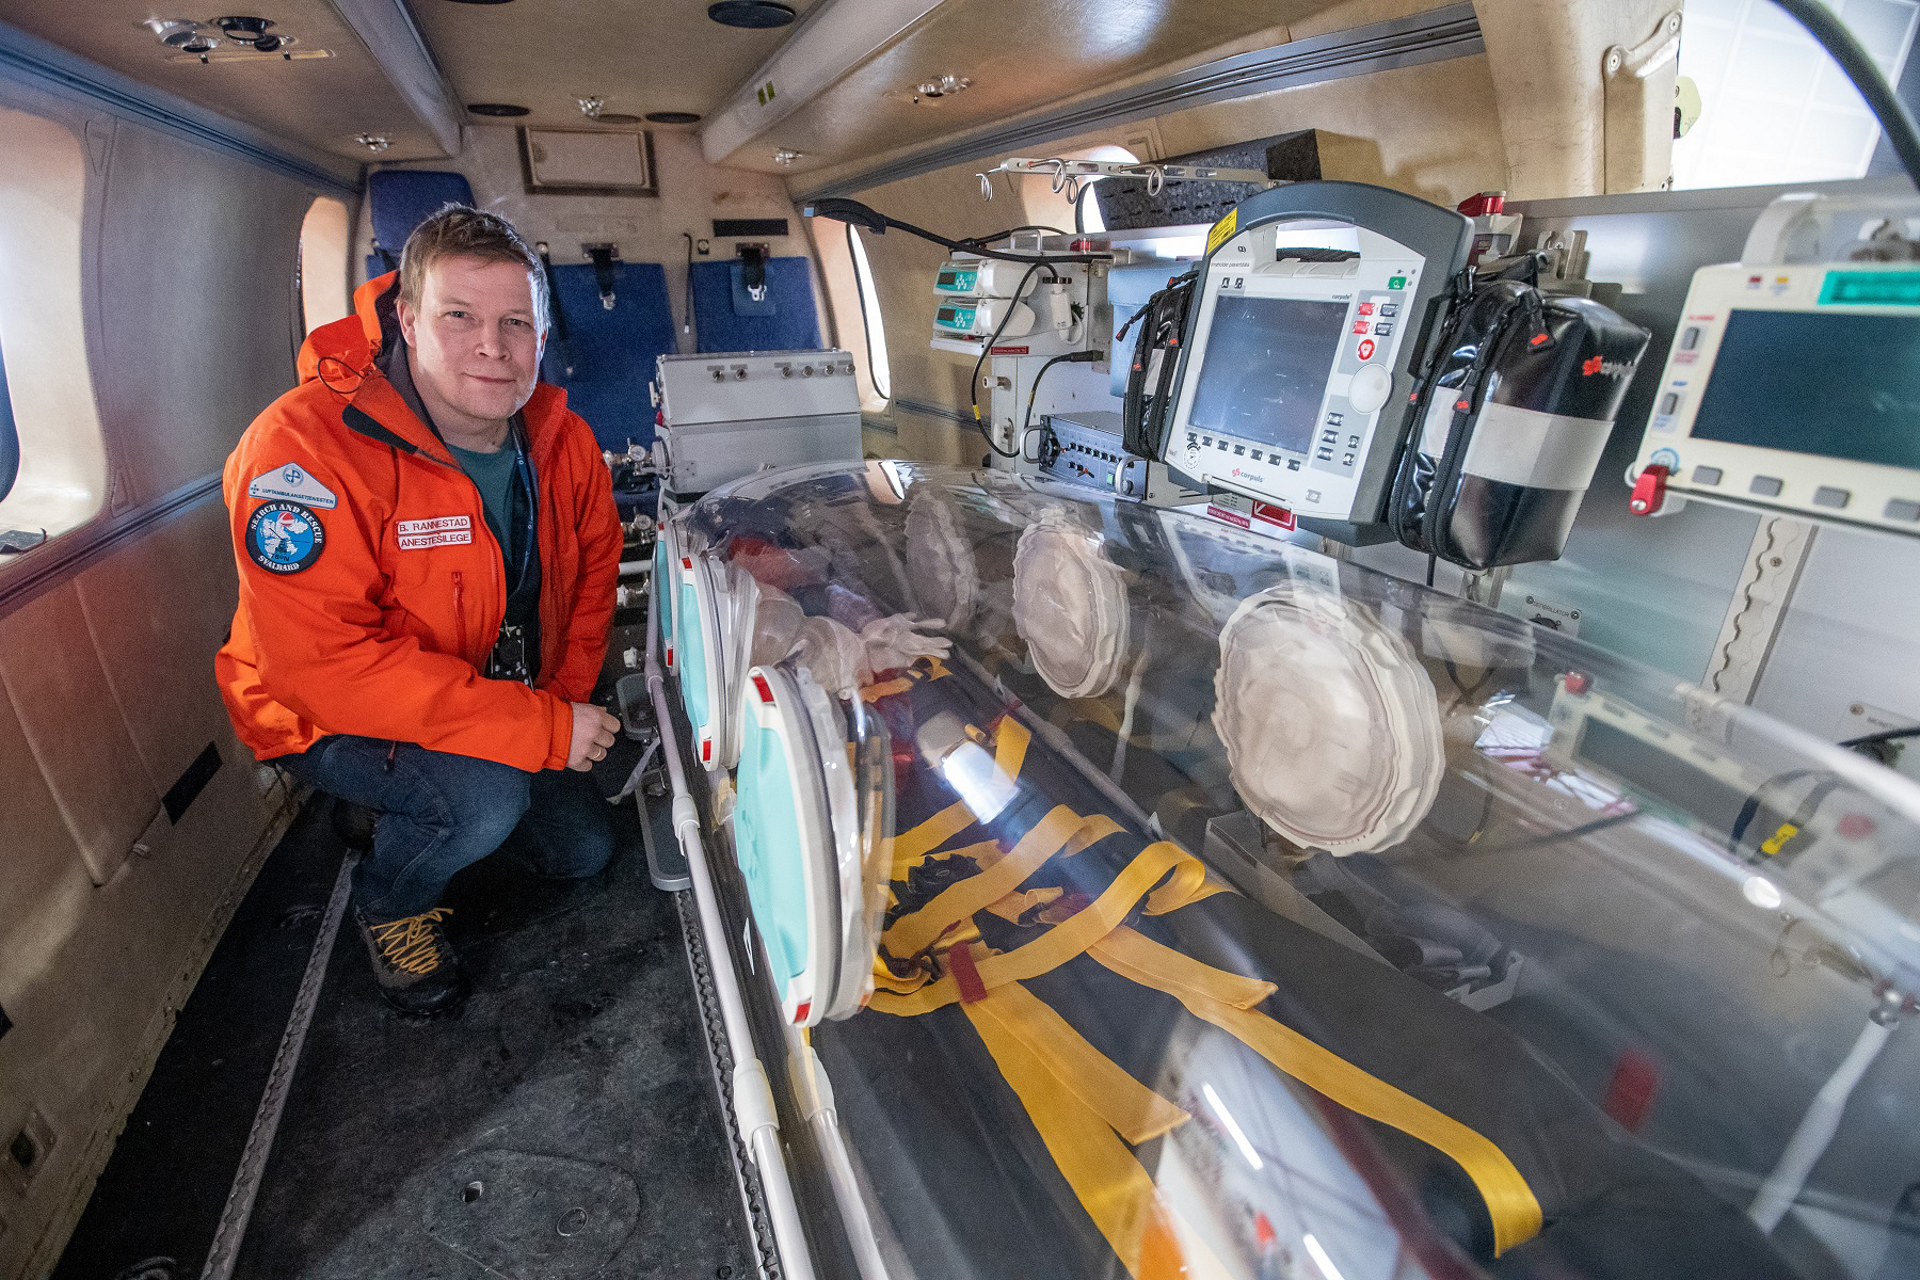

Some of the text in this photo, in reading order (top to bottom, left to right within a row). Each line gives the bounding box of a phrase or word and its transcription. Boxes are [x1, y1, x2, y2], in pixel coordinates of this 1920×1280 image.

[1240, 470, 1264, 483] corpuls
[262, 488, 334, 504] LUFTAMBULANSETJENESTEN
[251, 503, 323, 544] SEARCH AND RESCUE
[399, 518, 468, 532] B. RANNESTAD
[401, 533, 470, 547] ANESTESILEGE
[258, 555, 300, 571] SVALBARD
